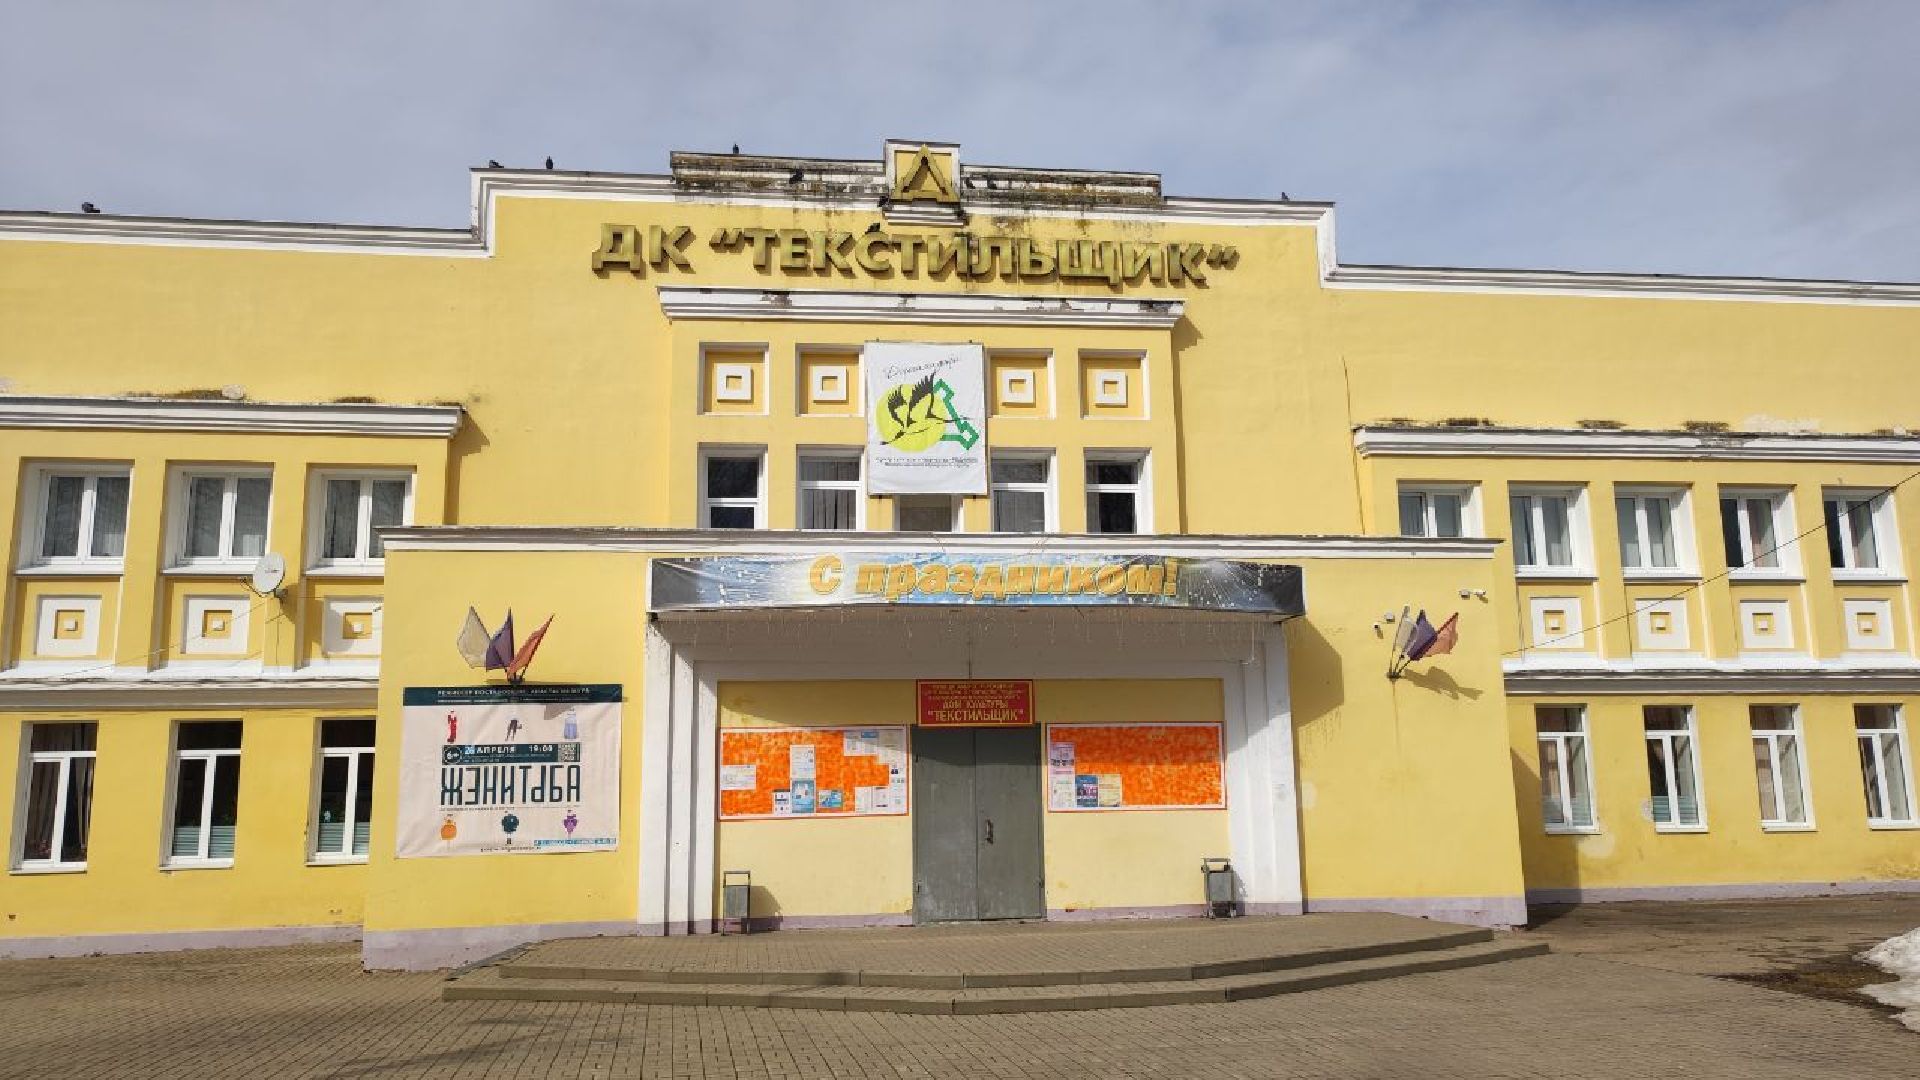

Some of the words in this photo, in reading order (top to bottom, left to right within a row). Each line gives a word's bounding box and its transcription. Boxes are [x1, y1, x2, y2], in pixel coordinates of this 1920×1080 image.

[592, 223, 692, 272] ДК
[709, 227, 1237, 287] "ТЕКСТИЛЬЩИК"
[809, 554, 844, 596] С
[856, 557, 1178, 600] праздником!
[927, 709, 1024, 723] "ТЕКСТИЛЬЩИК"
[477, 745, 516, 754] АПРЕЛЯ
